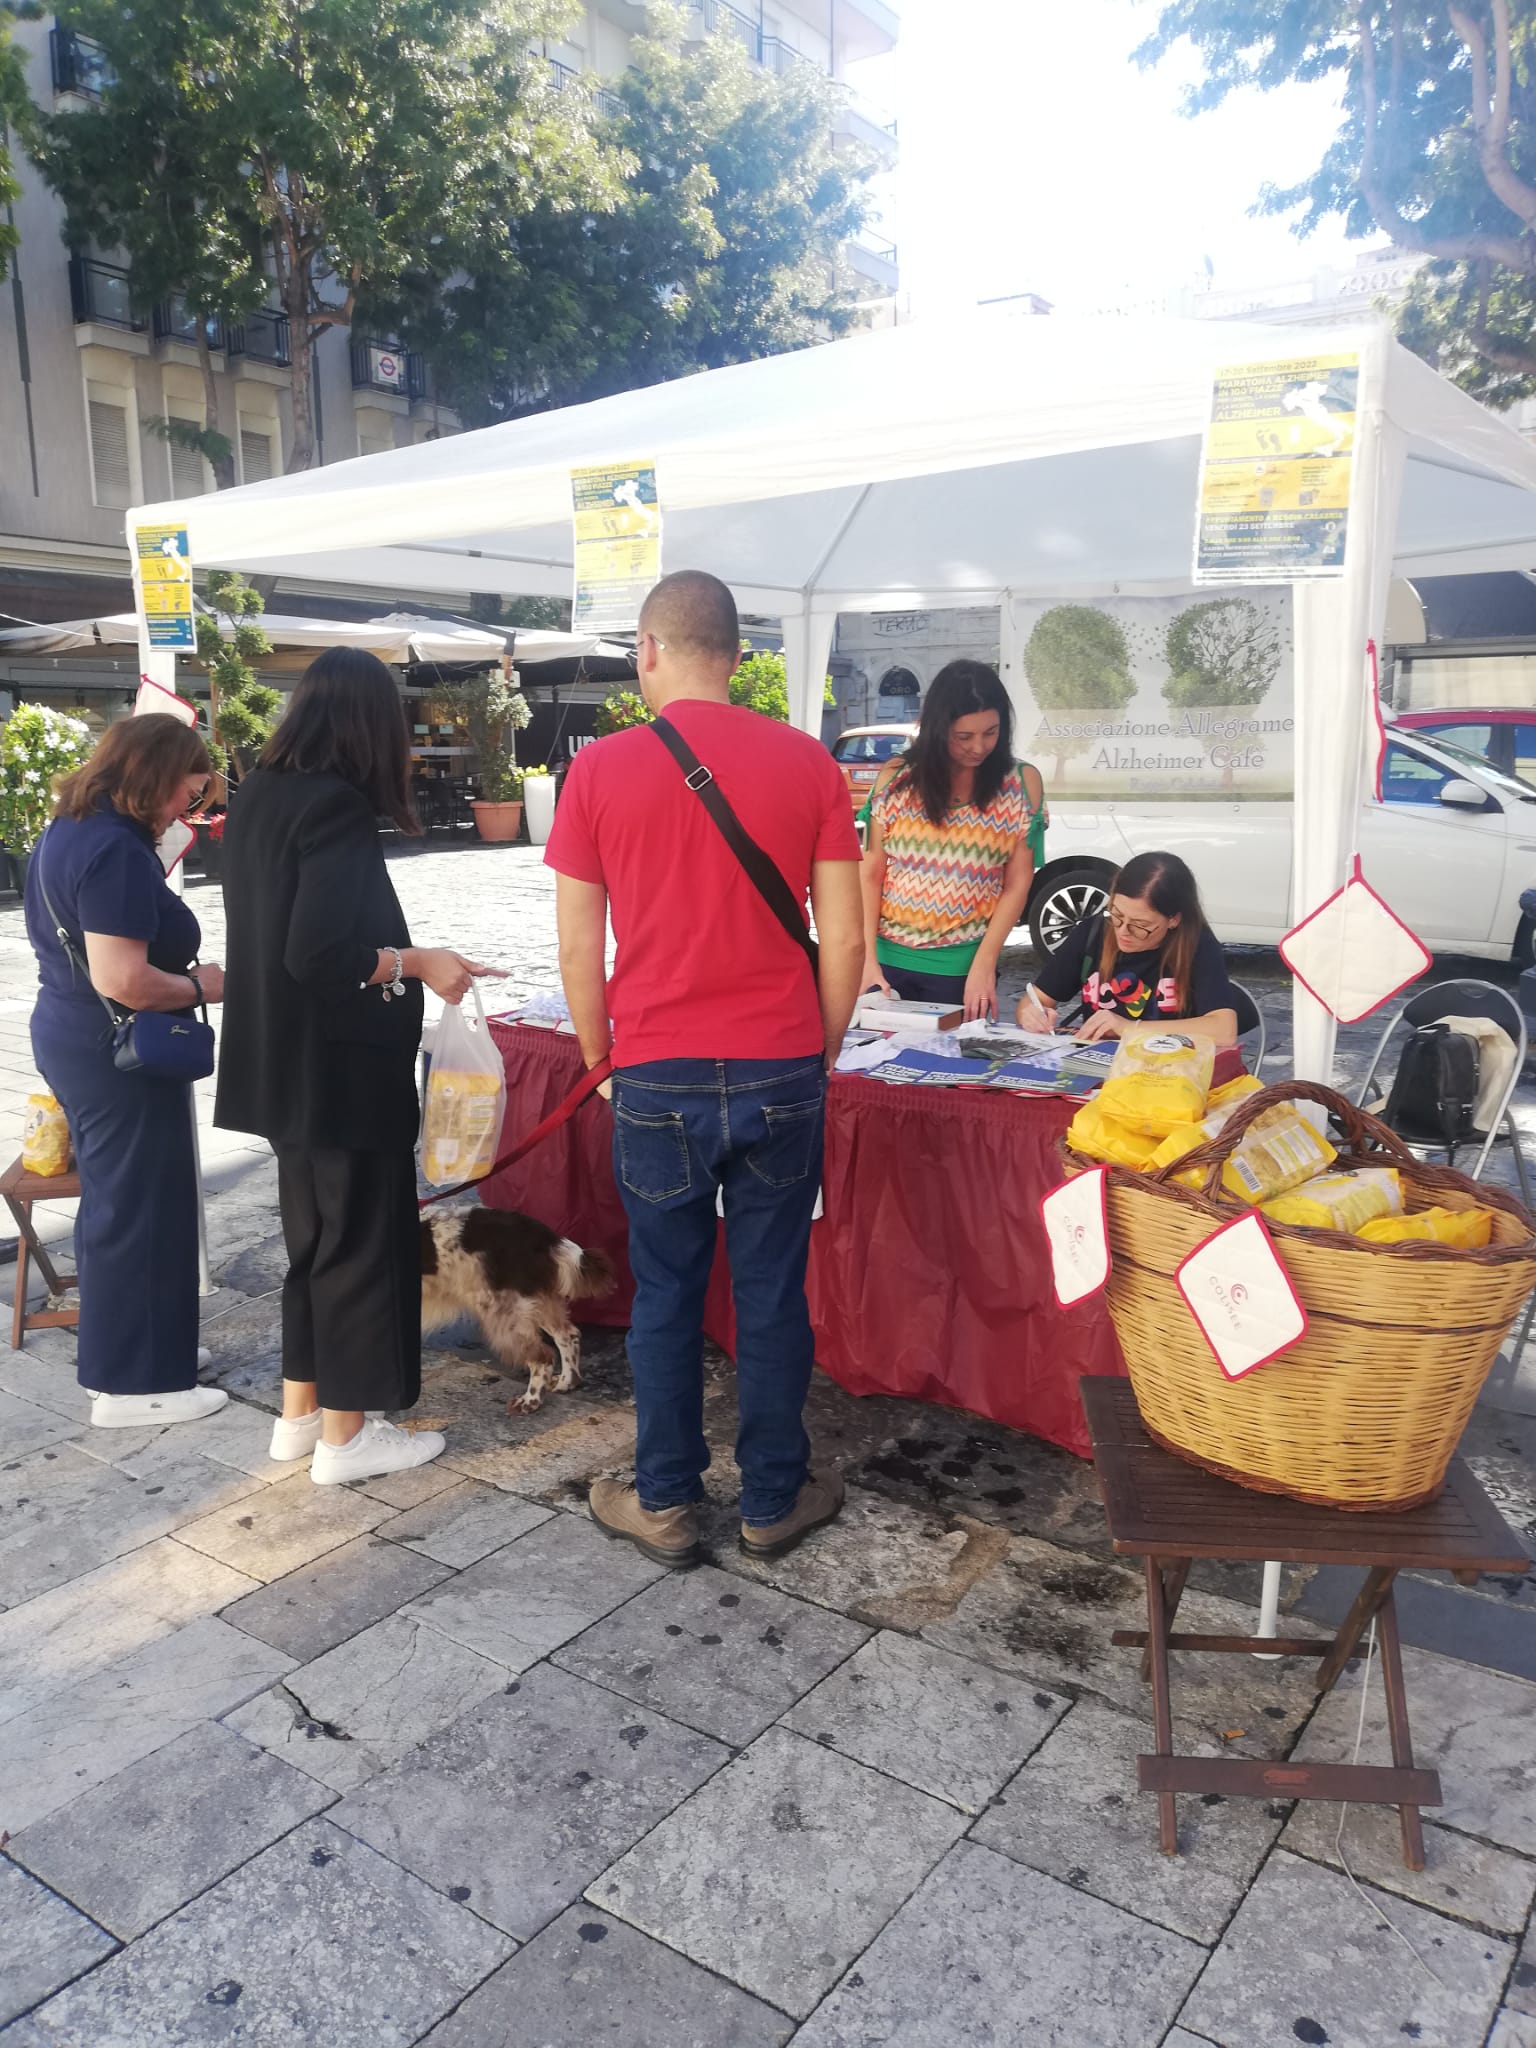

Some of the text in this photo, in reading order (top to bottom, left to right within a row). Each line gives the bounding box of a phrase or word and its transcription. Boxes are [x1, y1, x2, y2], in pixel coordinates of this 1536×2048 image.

[1294, 360, 1318, 370] 2022
[1216, 408, 1281, 420] ALZHEIMER
[1034, 714, 1171, 738] Associazione
[1092, 747, 1206, 770] Alzheimer
